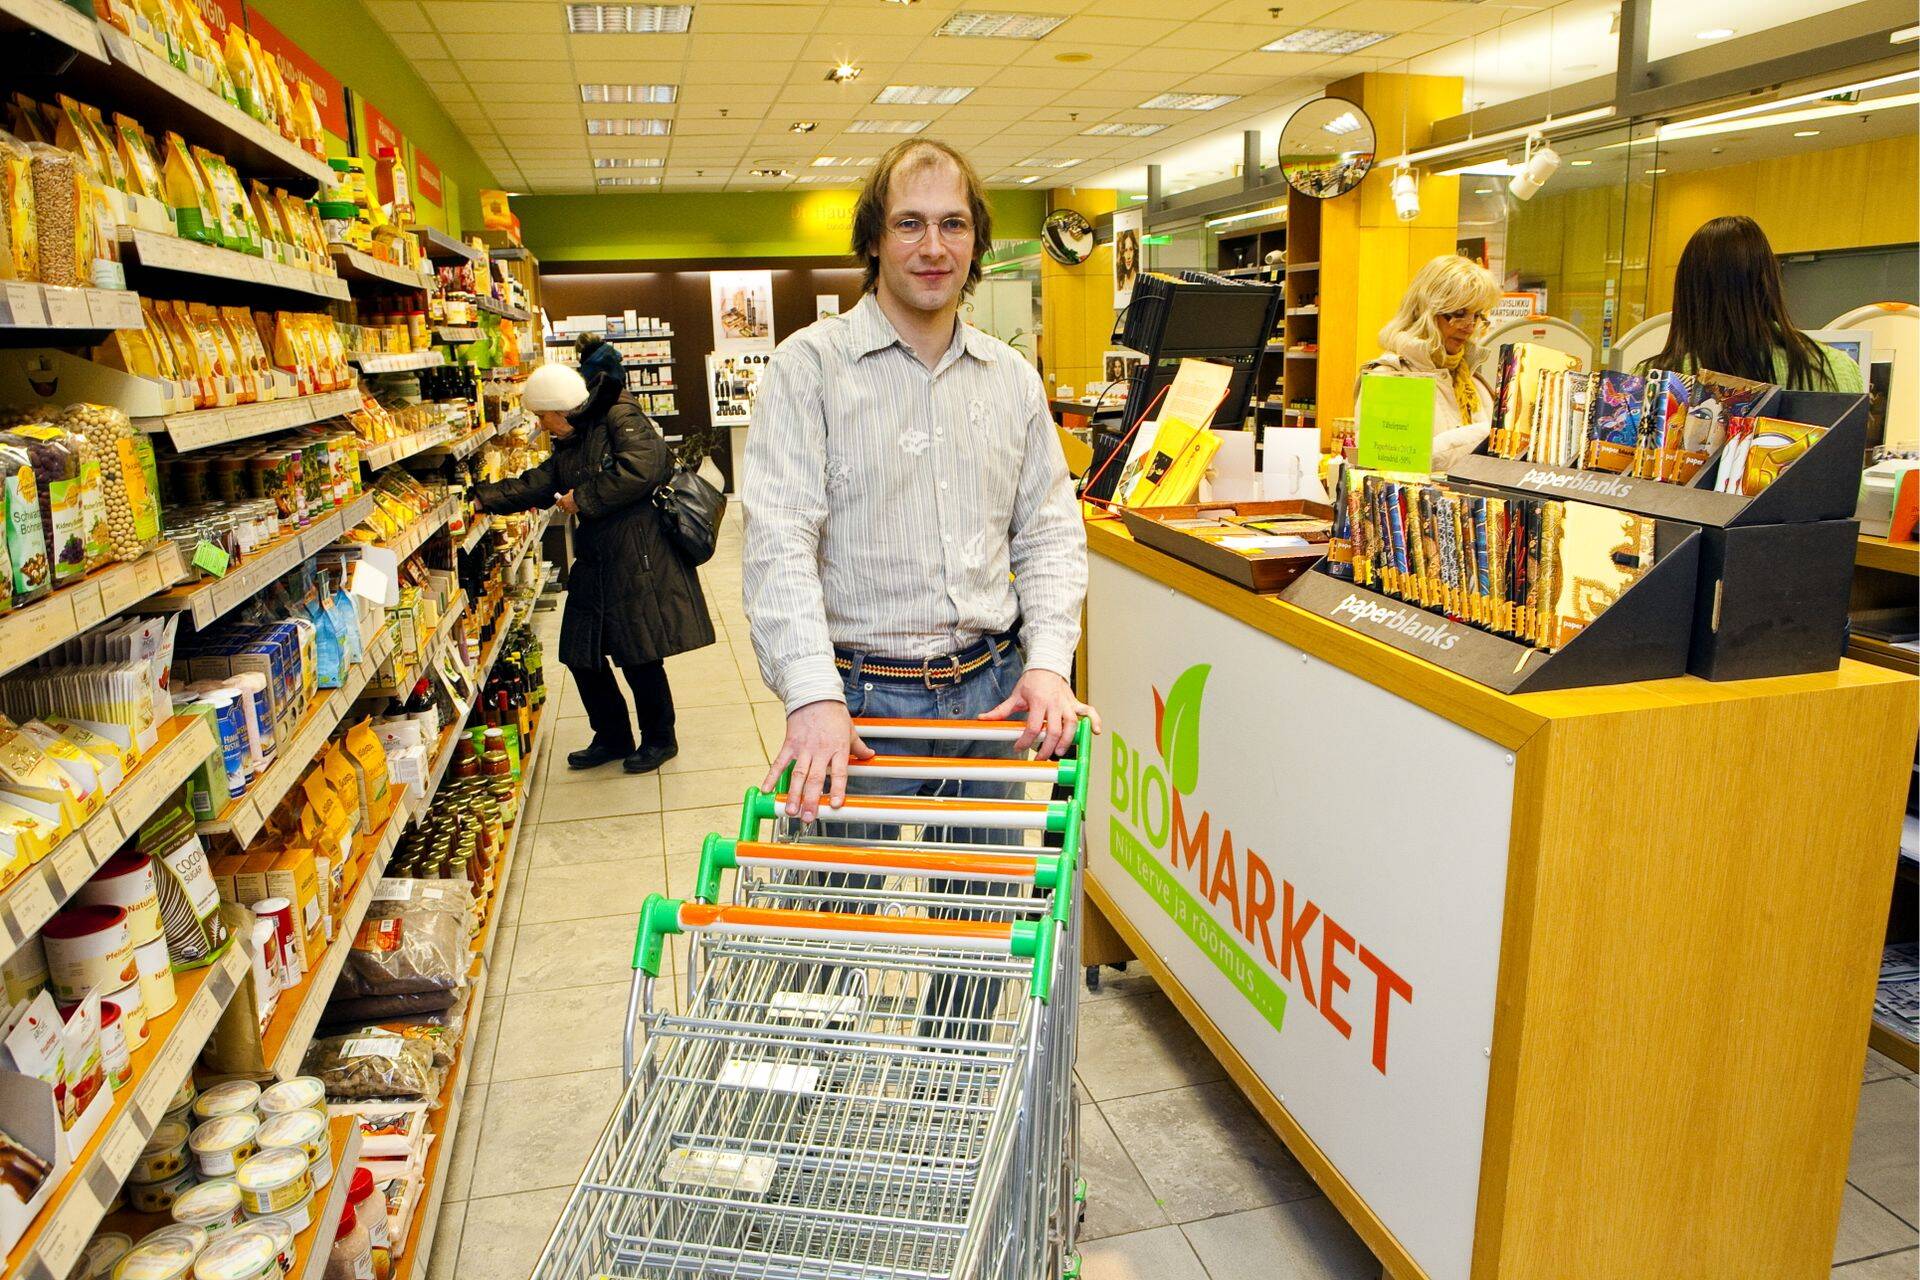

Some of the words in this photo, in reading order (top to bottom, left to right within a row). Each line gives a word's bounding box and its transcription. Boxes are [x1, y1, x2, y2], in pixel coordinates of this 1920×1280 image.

[1517, 468, 1633, 498] paperblanks
[1330, 593, 1460, 650] paperblanks
[1115, 831, 1132, 865] Nii
[1137, 855, 1170, 904] terve
[1173, 888, 1187, 921] ja
